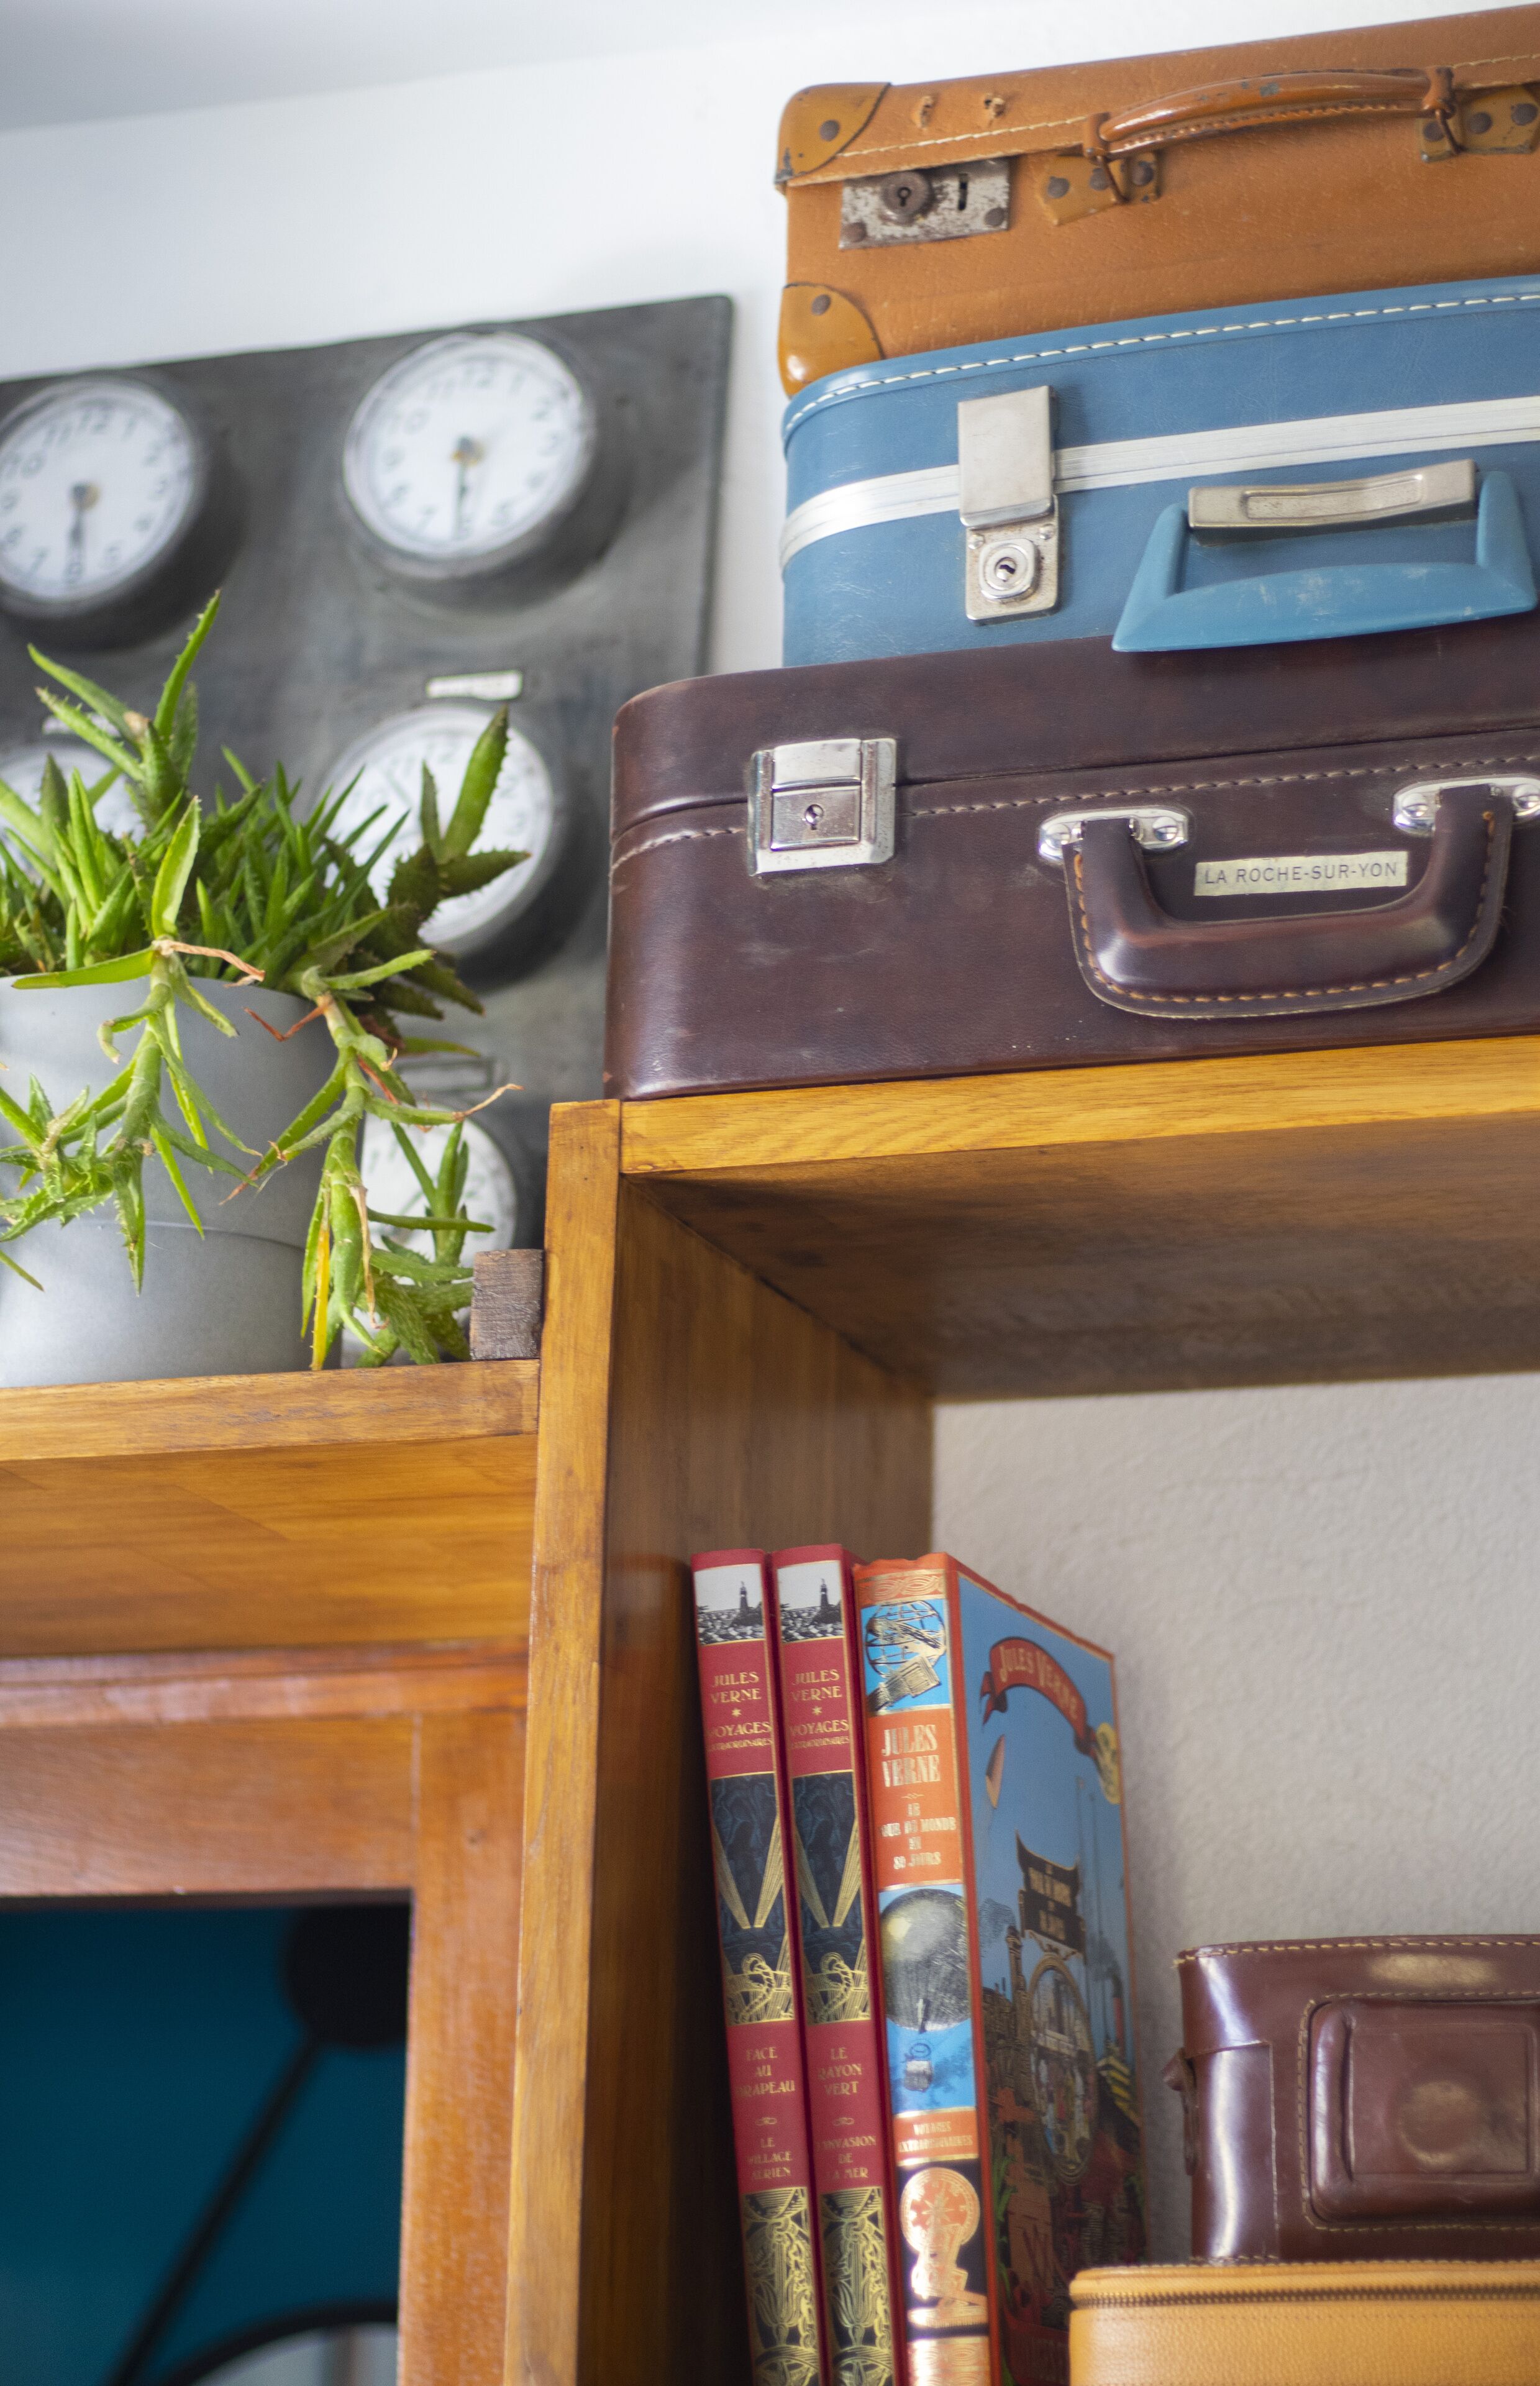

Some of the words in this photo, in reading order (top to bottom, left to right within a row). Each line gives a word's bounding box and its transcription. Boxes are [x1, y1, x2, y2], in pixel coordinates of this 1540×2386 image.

[1205, 870, 1227, 884] LA
[1236, 862, 1397, 883] ROCHE-SUR-YON
[712, 1671, 760, 1687] JULES
[792, 1669, 841, 1685] JULES
[711, 1688, 762, 1704] VERNE
[791, 1686, 842, 1703] VERNE
[881, 1724, 938, 1757] JULES
[881, 1755, 941, 1788] VERNE
[745, 2046, 778, 2061] FACE
[831, 2047, 847, 2061] LE
[755, 2064, 772, 2078] AU
[818, 2063, 862, 2080] RAYON
[824, 2081, 859, 2096] VERT
